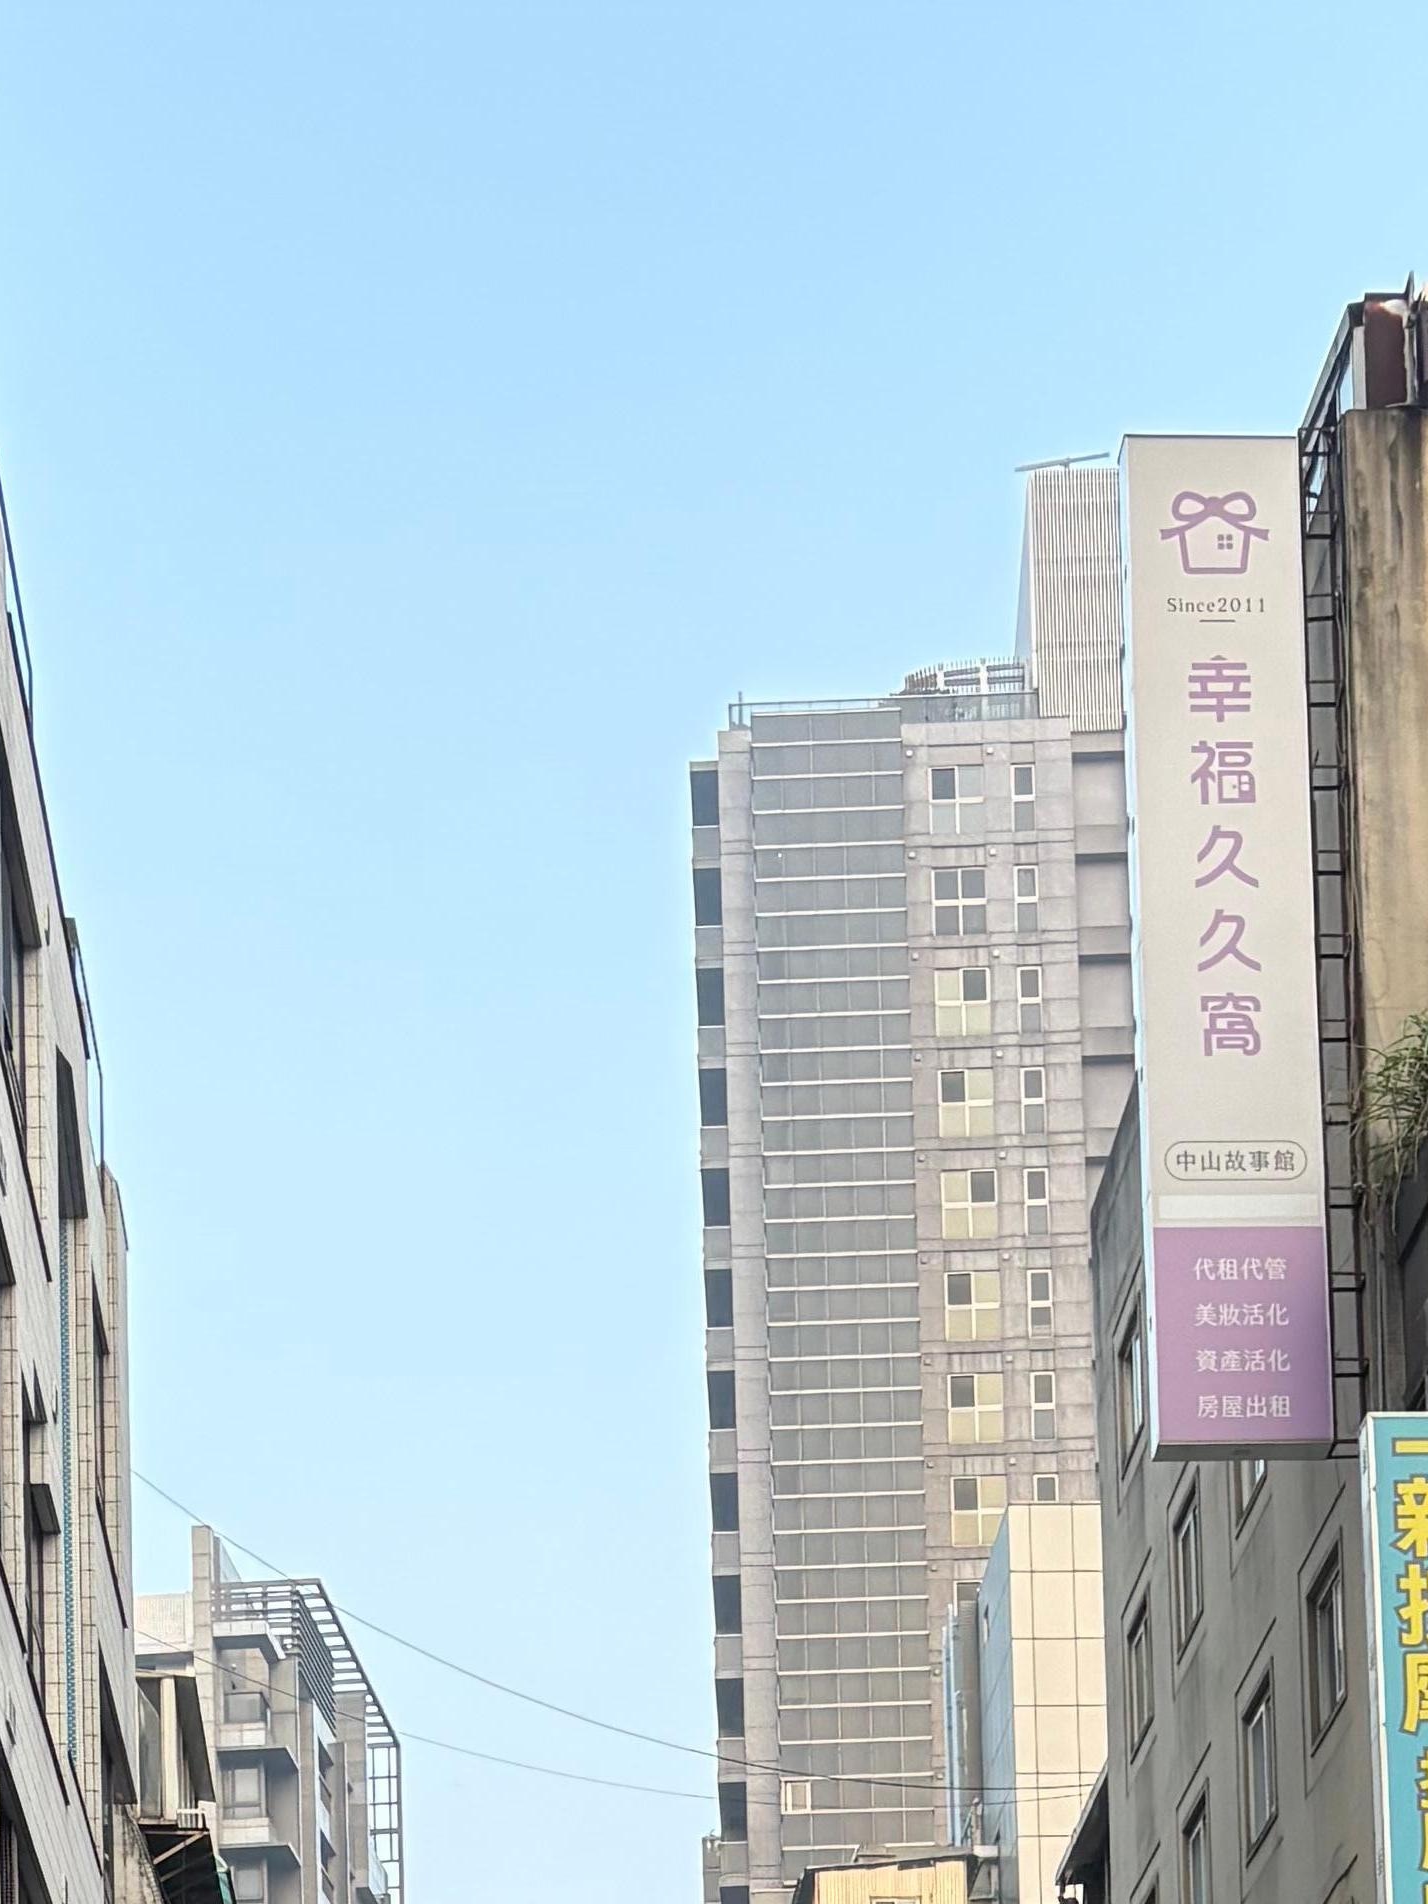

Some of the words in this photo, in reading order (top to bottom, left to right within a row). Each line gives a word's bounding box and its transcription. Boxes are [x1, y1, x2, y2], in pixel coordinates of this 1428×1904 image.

[1167, 597, 1266, 613] Since2011
[1186, 652, 1264, 1058] 幸福久久窩
[1176, 1150, 1295, 1173] 中山故事館
[1194, 1257, 1288, 1281] 代租代管
[1195, 1348, 1290, 1372] 資產活化
[1197, 1394, 1291, 1418] 房屋出租
